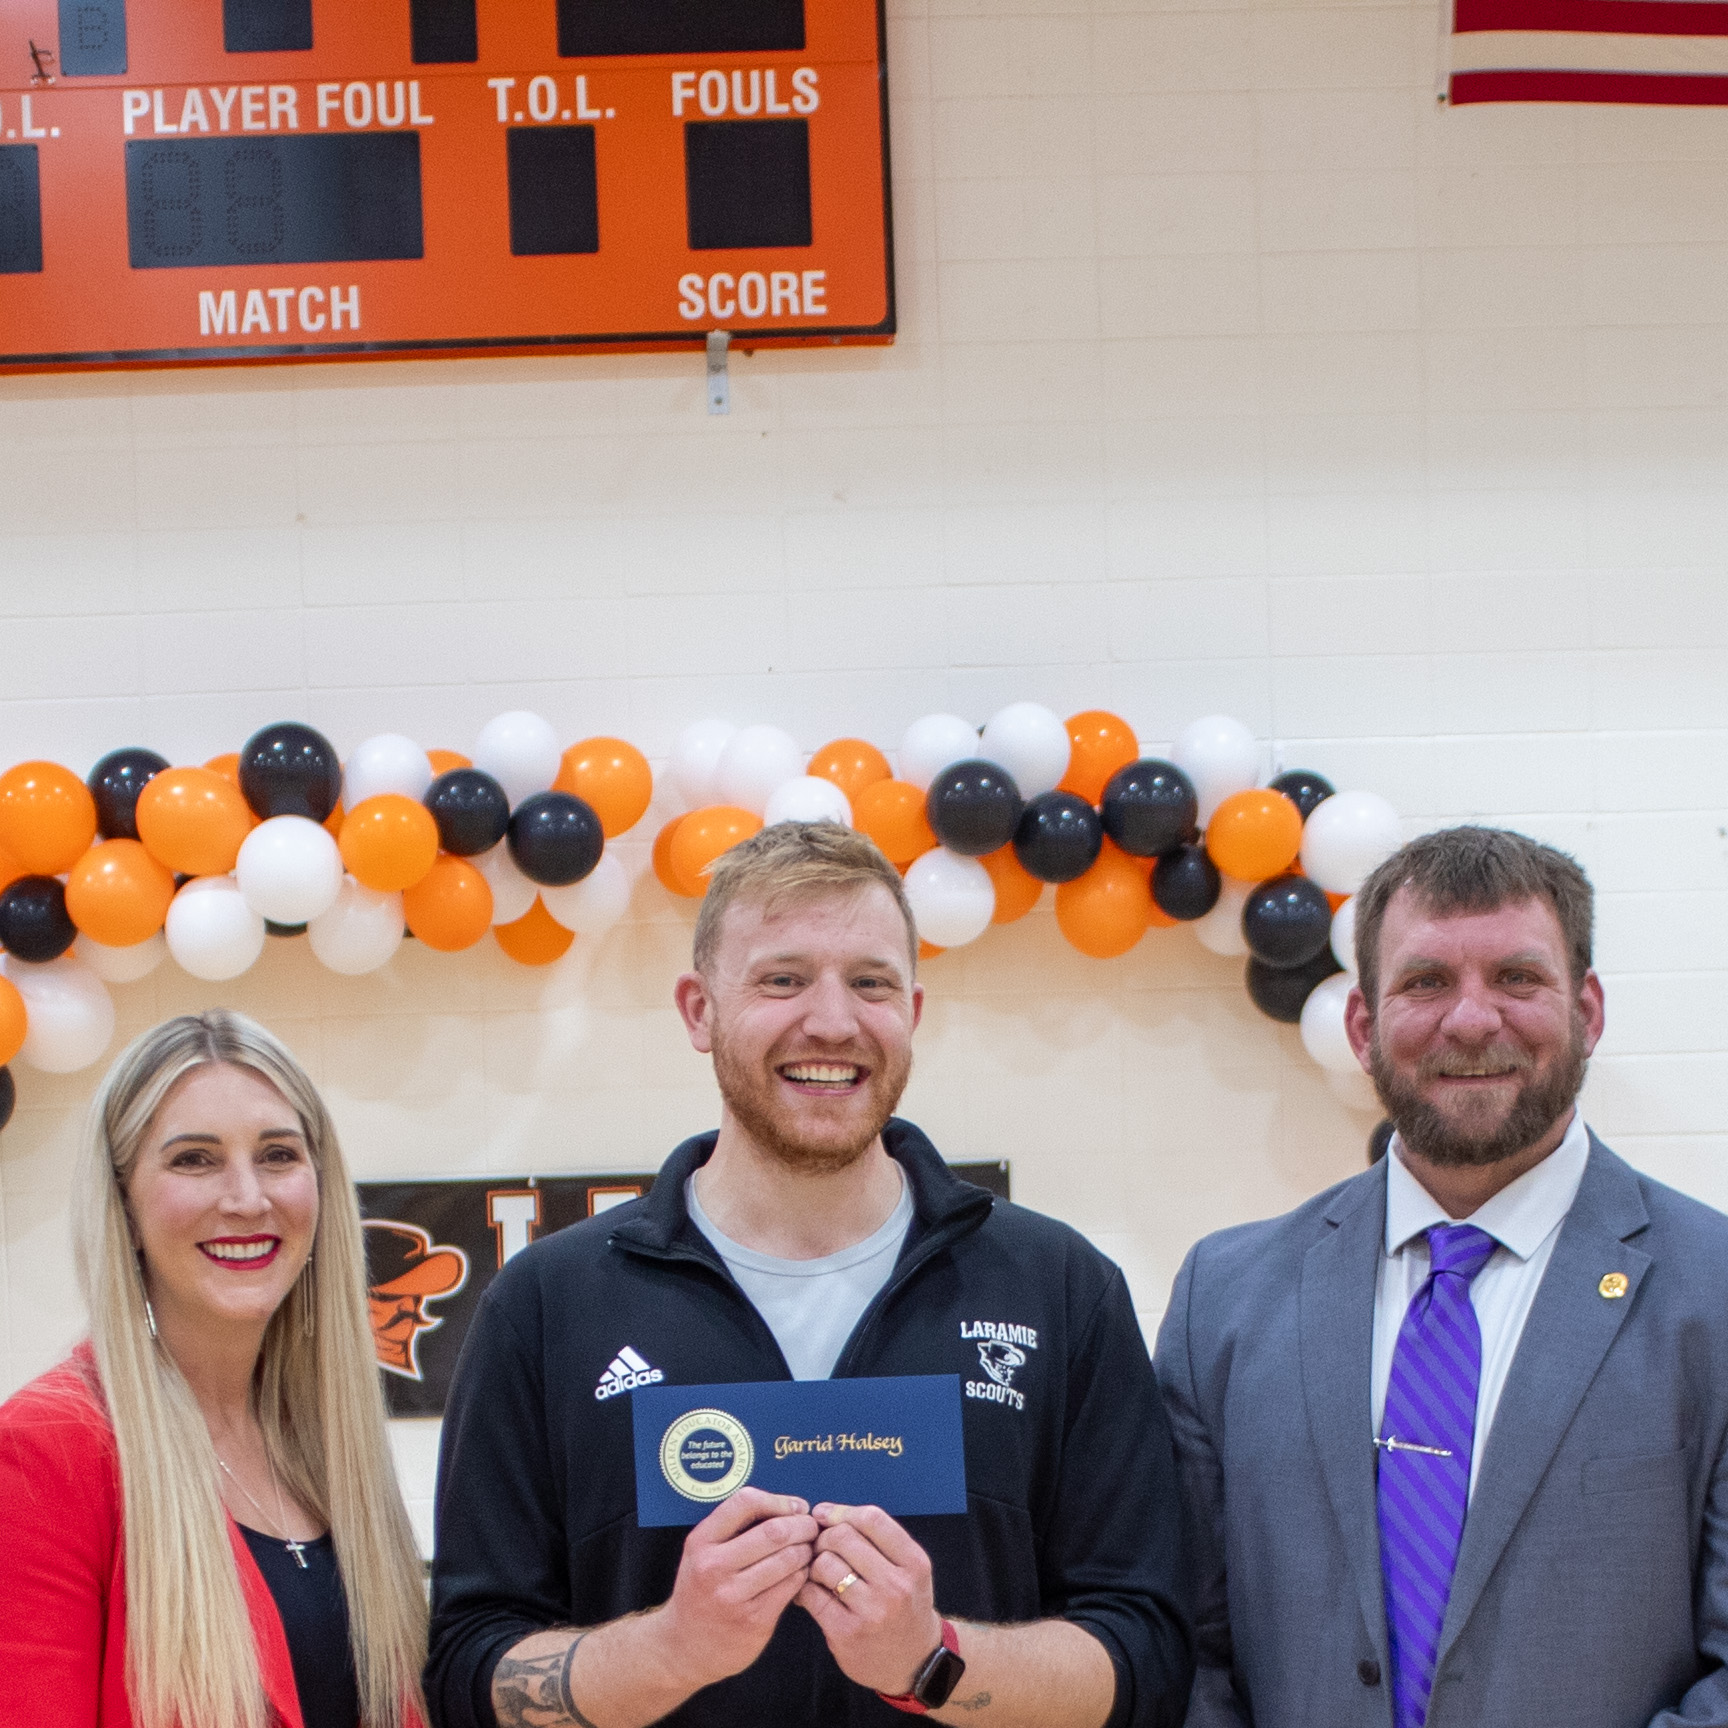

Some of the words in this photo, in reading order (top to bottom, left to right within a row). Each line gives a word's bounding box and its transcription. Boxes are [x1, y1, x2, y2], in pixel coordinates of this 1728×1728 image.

[121, 86, 299, 137] PLAYER
[316, 81, 435, 129] FOUL
[487, 75, 616, 123] T.O.L.
[671, 68, 820, 117] FOULS
[197, 285, 361, 336] MATCH
[678, 270, 828, 320] SCORE
[960, 1320, 1038, 1350] LARAMIE
[594, 1368, 664, 1401] adidas
[965, 1380, 1025, 1411] SCOUTS
[667, 1439, 682, 1480] MILKEN
[675, 1416, 732, 1437] EDUCATOR
[731, 1433, 747, 1478] AWARDS
[681, 1451, 710, 1460] belongs
[711, 1451, 719, 1459] to
[720, 1450, 734, 1458] the
[688, 1440, 702, 1449] The
[702, 1440, 726, 1450] future
[774, 1434, 834, 1459] Garrid
[835, 1432, 903, 1457] Halsey
[690, 1460, 725, 1469] educated
